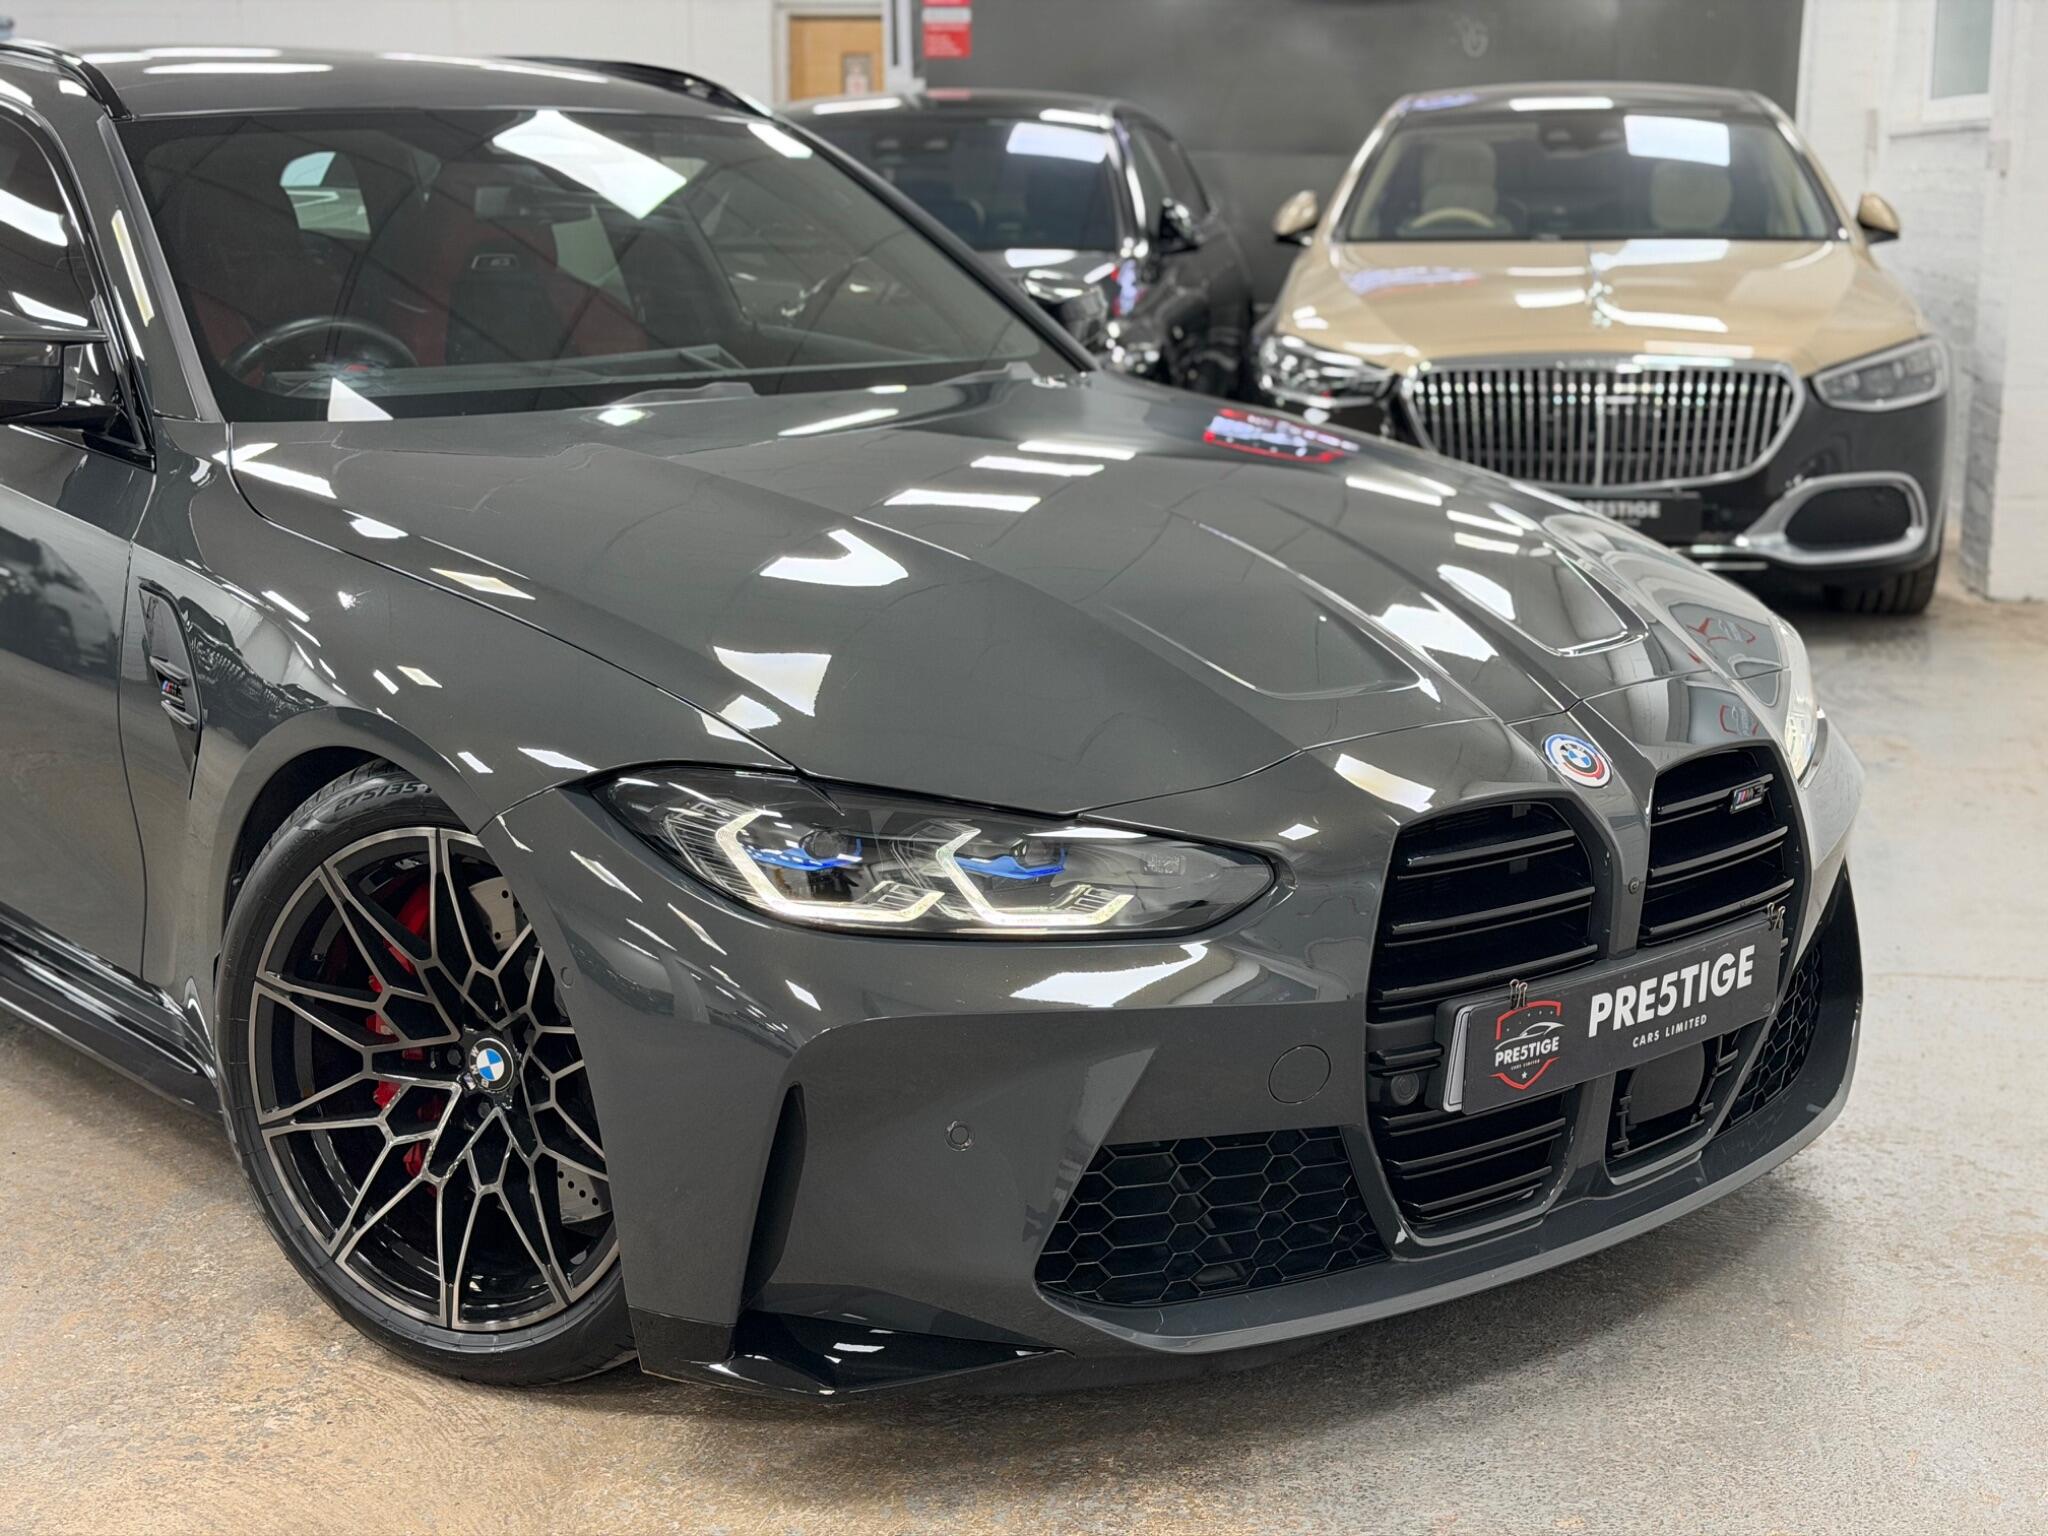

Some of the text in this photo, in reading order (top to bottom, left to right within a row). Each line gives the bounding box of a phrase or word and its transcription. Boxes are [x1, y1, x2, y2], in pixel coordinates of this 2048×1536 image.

[1588, 944, 1755, 1038] PRE5TIGE
[1632, 1014, 1707, 1048] CARS LIMITED
[1495, 1036, 1560, 1067] PRE5TIGE
